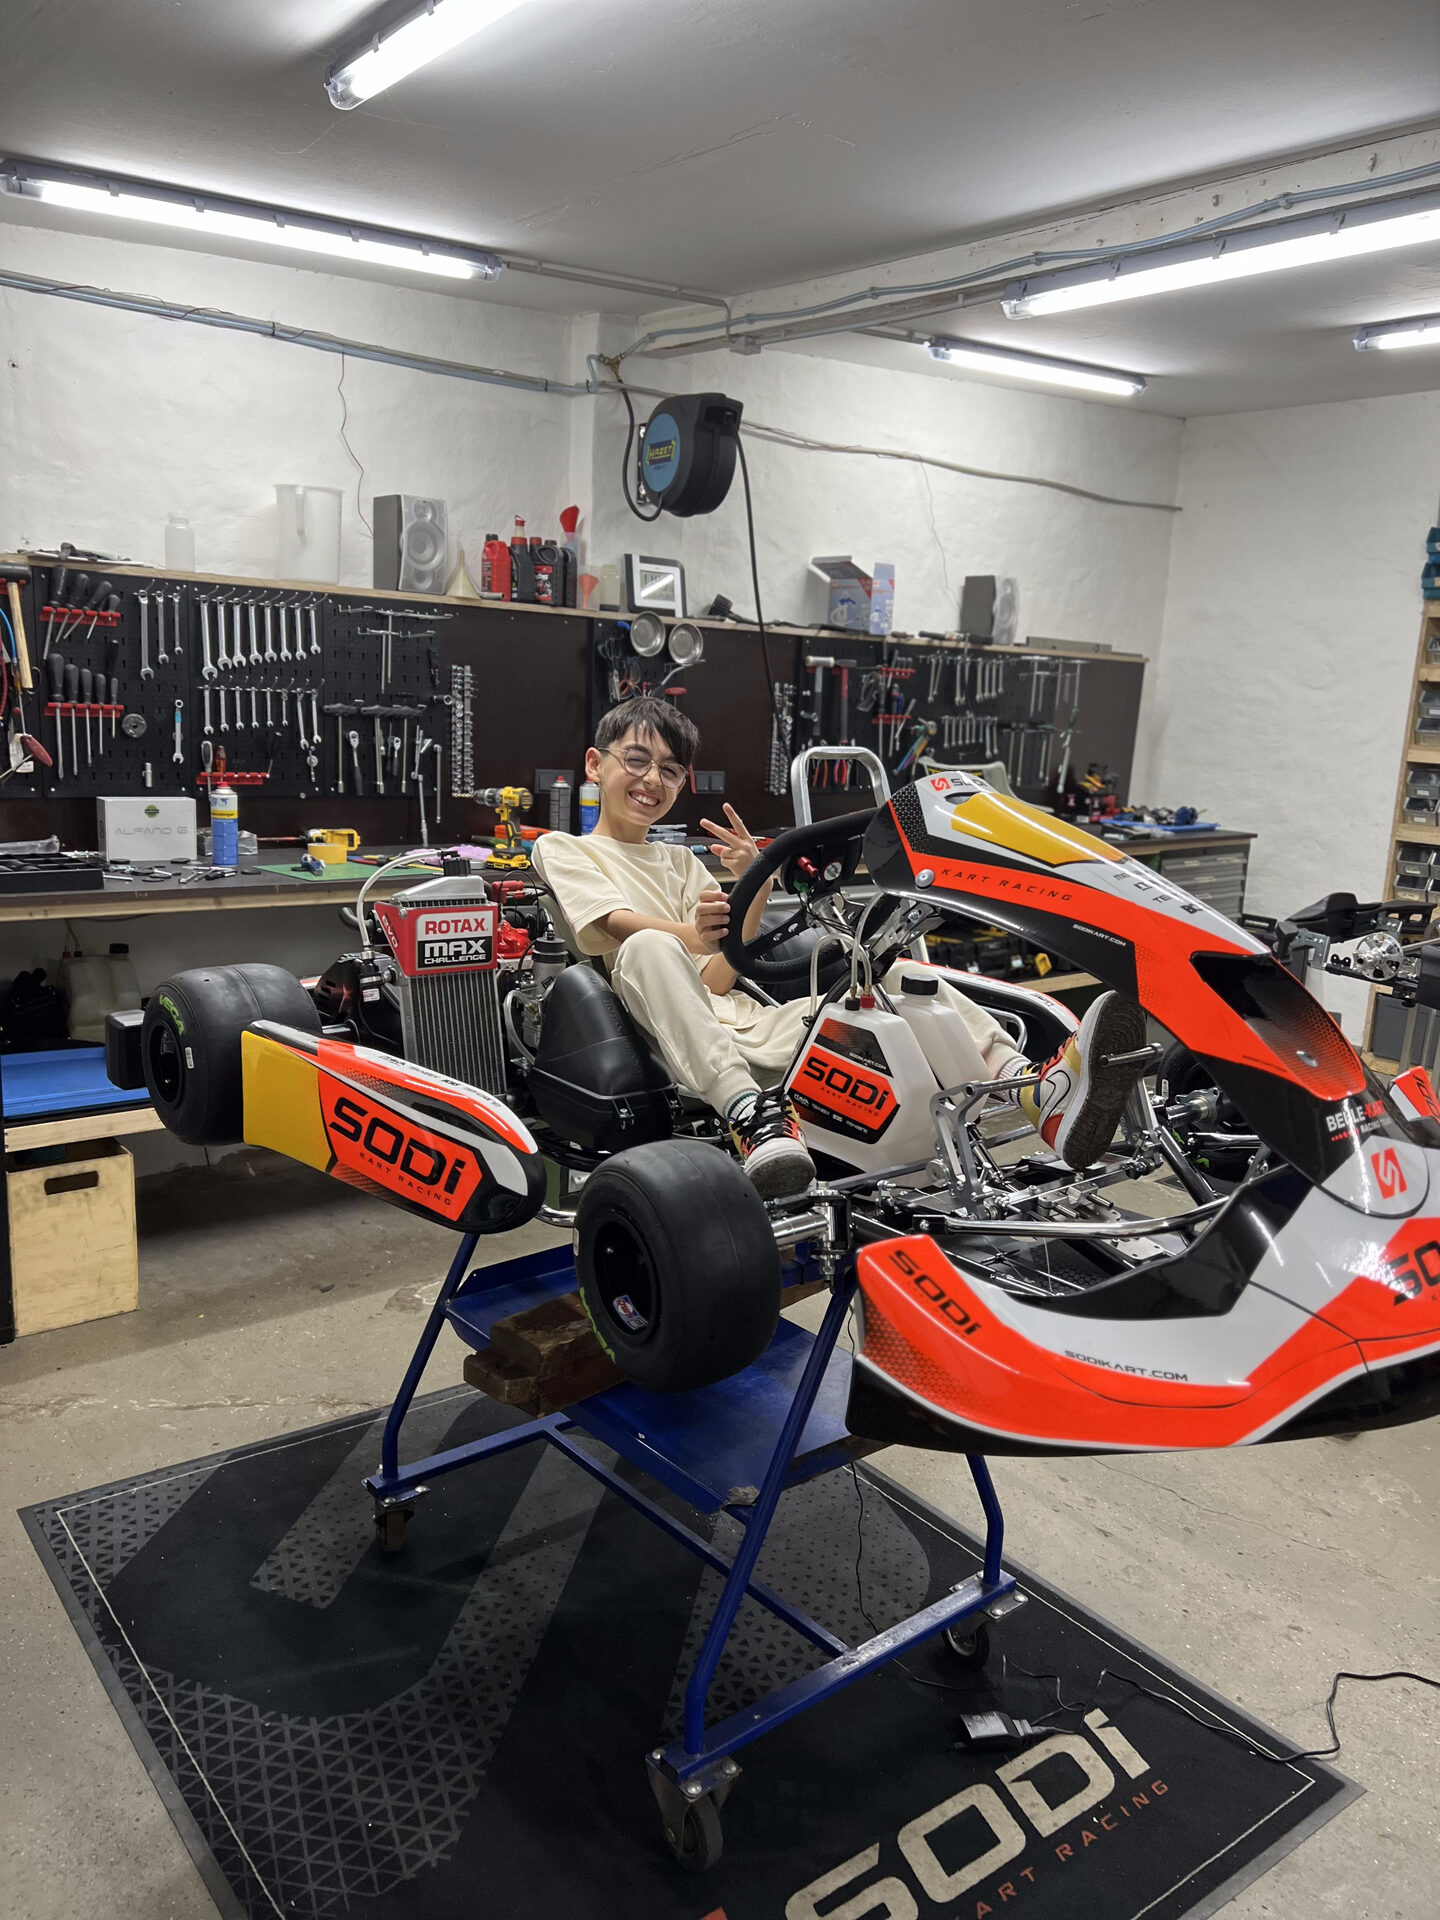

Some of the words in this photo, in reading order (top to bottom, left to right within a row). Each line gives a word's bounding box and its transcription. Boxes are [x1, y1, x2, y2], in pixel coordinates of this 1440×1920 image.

[648, 445, 673, 460] HAZET
[114, 826, 172, 836] ALFANO
[941, 868, 989, 883] KART
[999, 879, 1073, 902] RACING
[425, 917, 487, 936] ROTAX
[1072, 923, 1127, 947] SODIKART.COM
[424, 939, 487, 958] MAX
[424, 953, 487, 965] CHALLENGE
[159, 994, 185, 1036] VEGA
[359, 1151, 392, 1175] KART
[397, 1175, 452, 1207] RACING
[1064, 1349, 1188, 1382] SODIKART.COM
[954, 1866, 1036, 1920] ART
[1055, 1779, 1169, 1862] RACING
